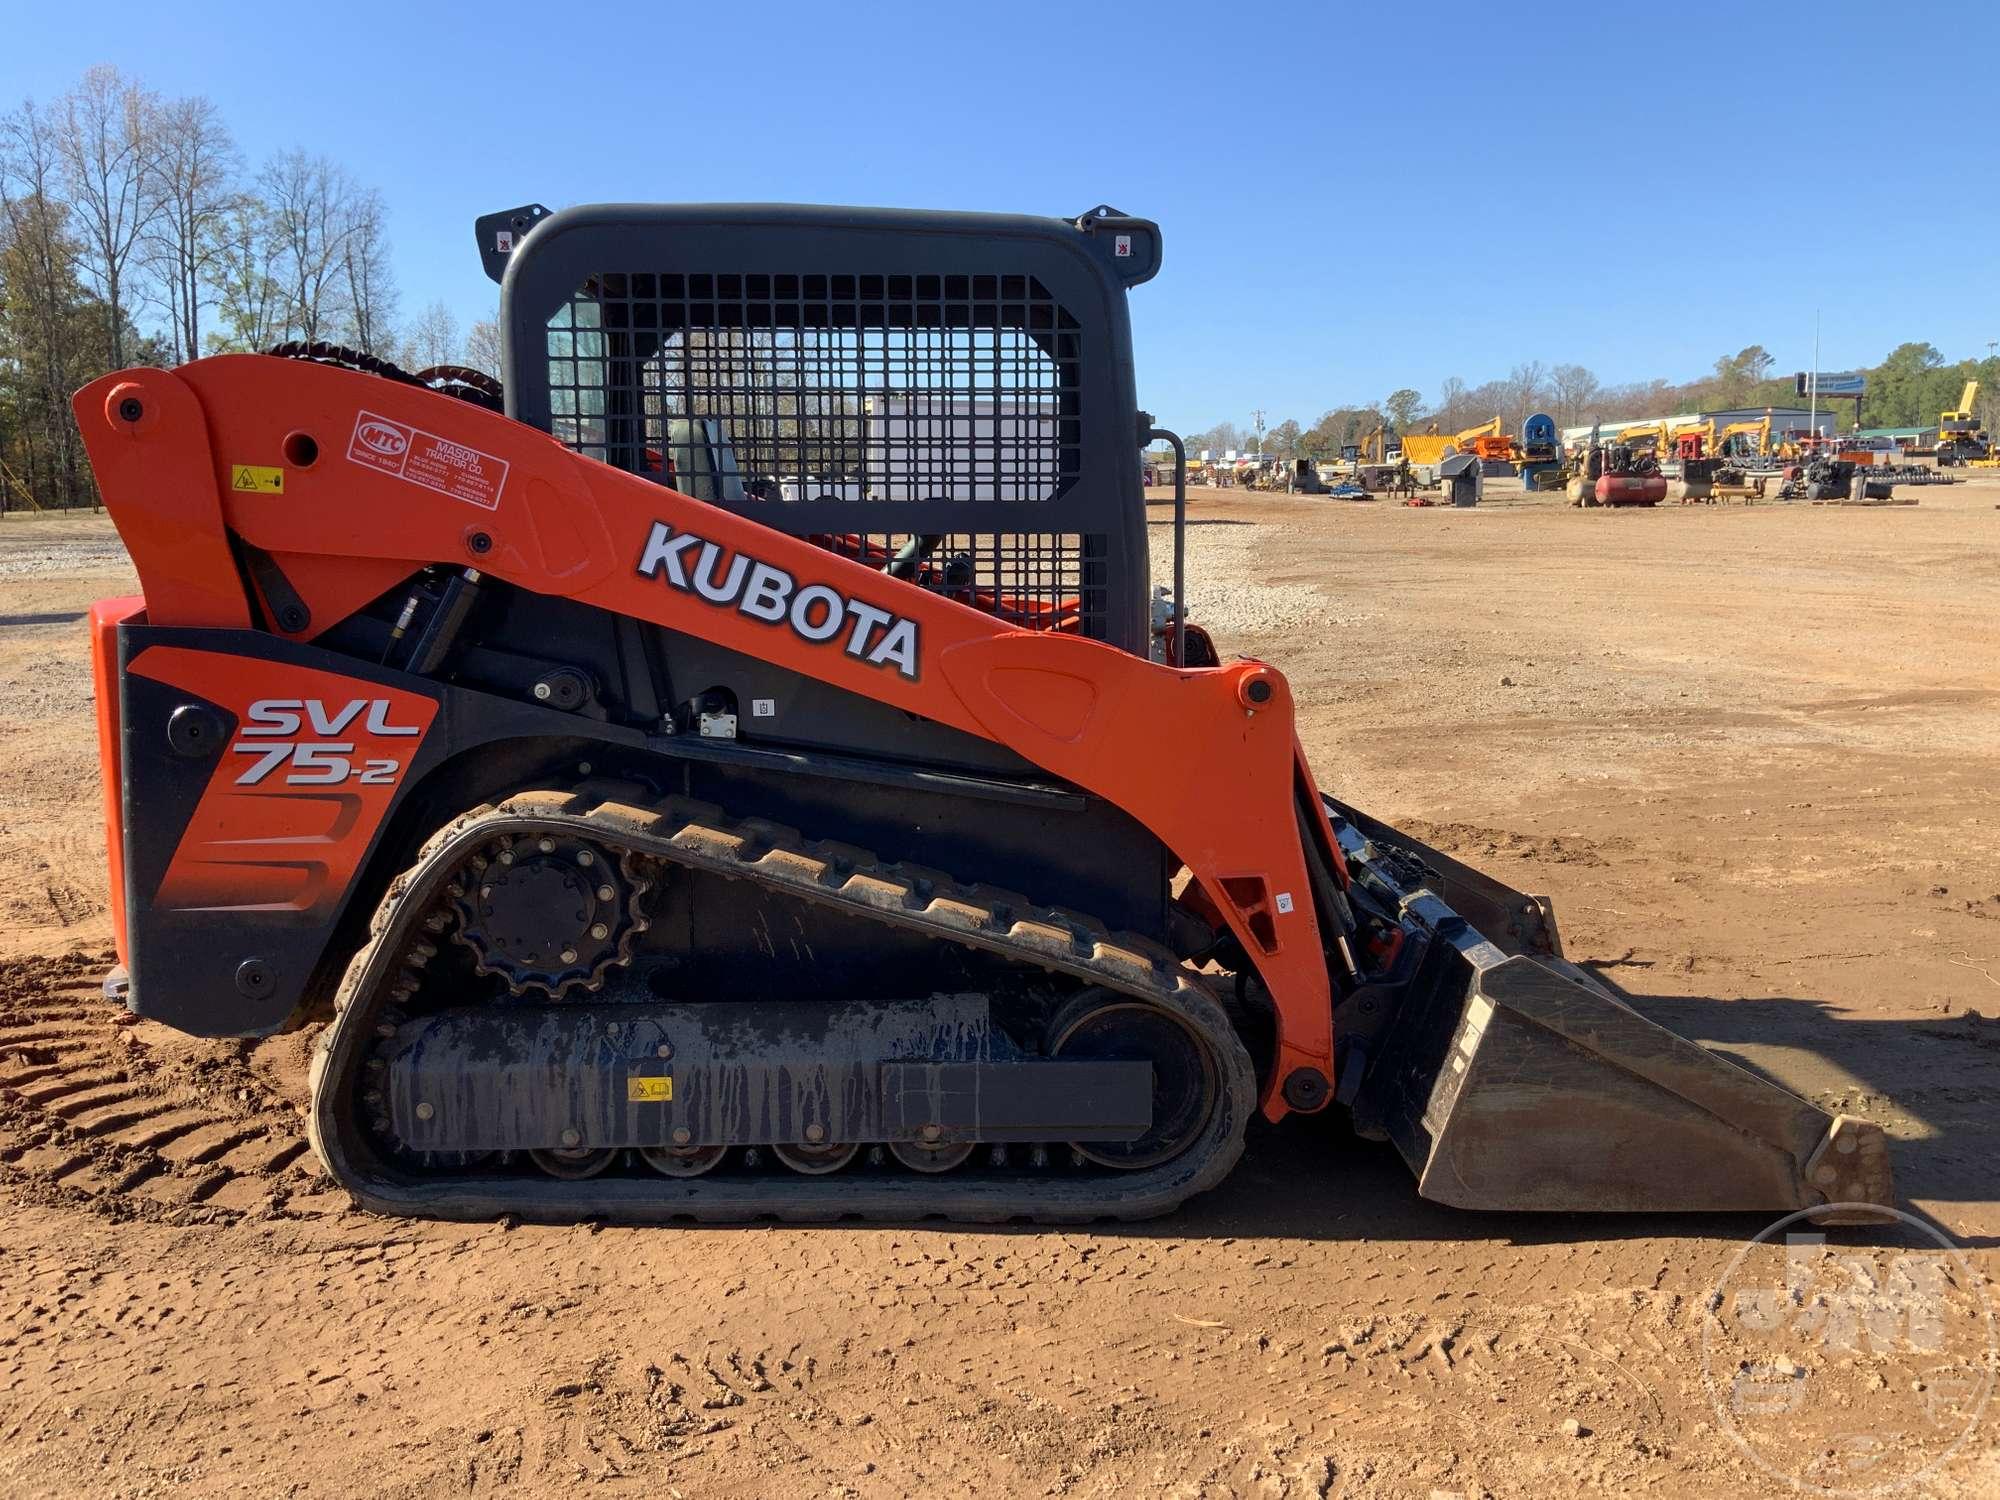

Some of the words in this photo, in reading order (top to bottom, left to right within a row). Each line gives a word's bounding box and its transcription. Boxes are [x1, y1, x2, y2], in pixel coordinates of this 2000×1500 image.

[425, 447, 467, 469] TRACTOR
[436, 441, 480, 464] MASON
[637, 520, 919, 679] KUBOTA
[241, 699, 420, 736] SVL
[232, 742, 399, 786] 75-2
